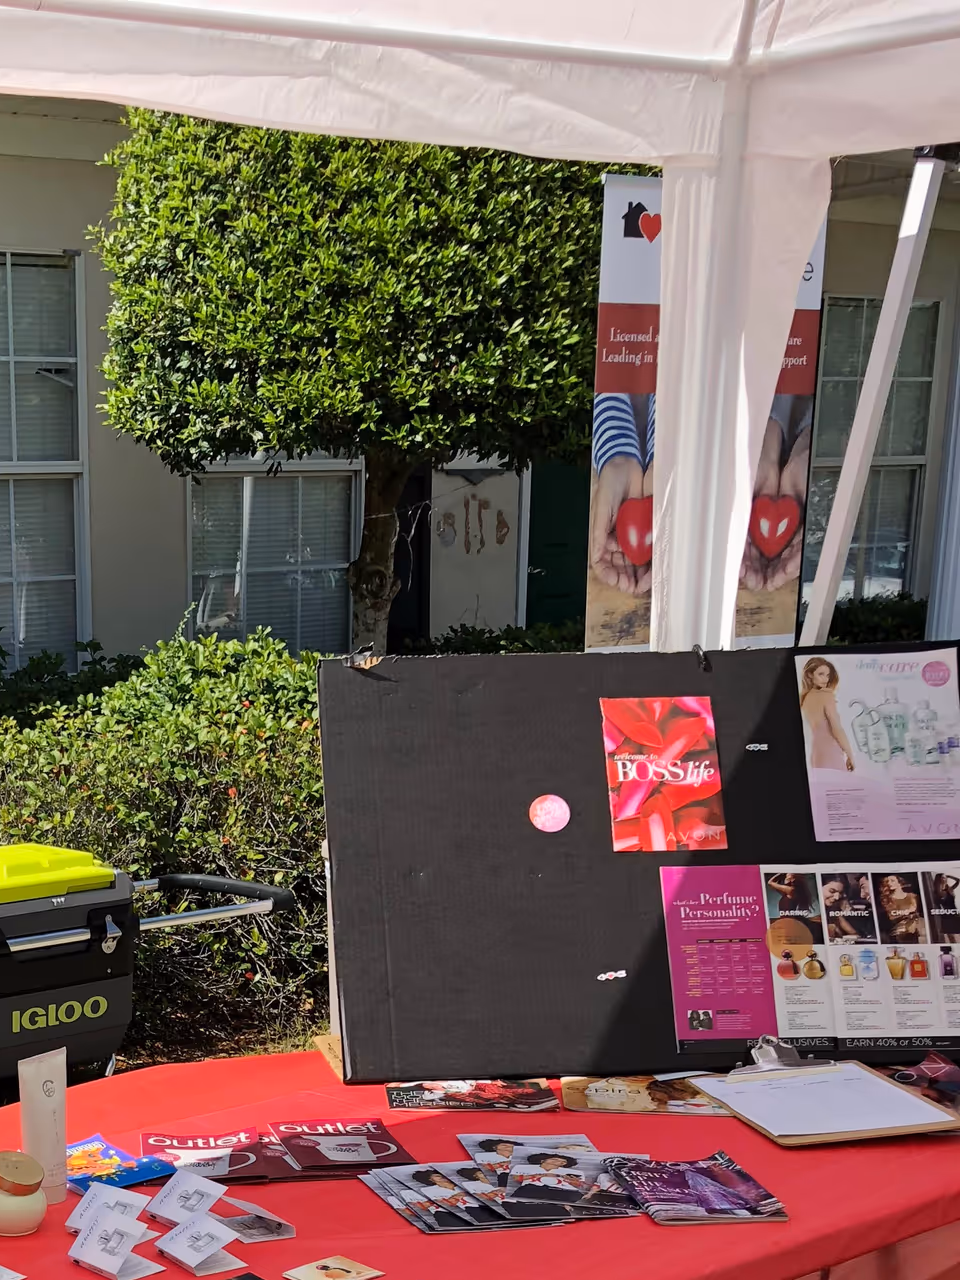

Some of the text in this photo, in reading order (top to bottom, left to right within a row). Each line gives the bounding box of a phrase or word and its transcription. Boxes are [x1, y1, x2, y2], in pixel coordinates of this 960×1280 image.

[609, 326, 653, 342] Licensed
[602, 348, 641, 366] Leading
[644, 349, 653, 364] in
[614, 760, 715, 787] BOSS life
[666, 831, 721, 841] AVON
[699, 892, 757, 905] Perfume
[680, 904, 760, 921] Personality?
[11, 995, 108, 1034] IGLOO
[846, 1038, 874, 1047] EARN
[876, 1038, 897, 1047] 40%
[911, 1038, 933, 1047] 50%
[279, 1122, 382, 1134] outlet
[147, 1131, 252, 1149] outlet
